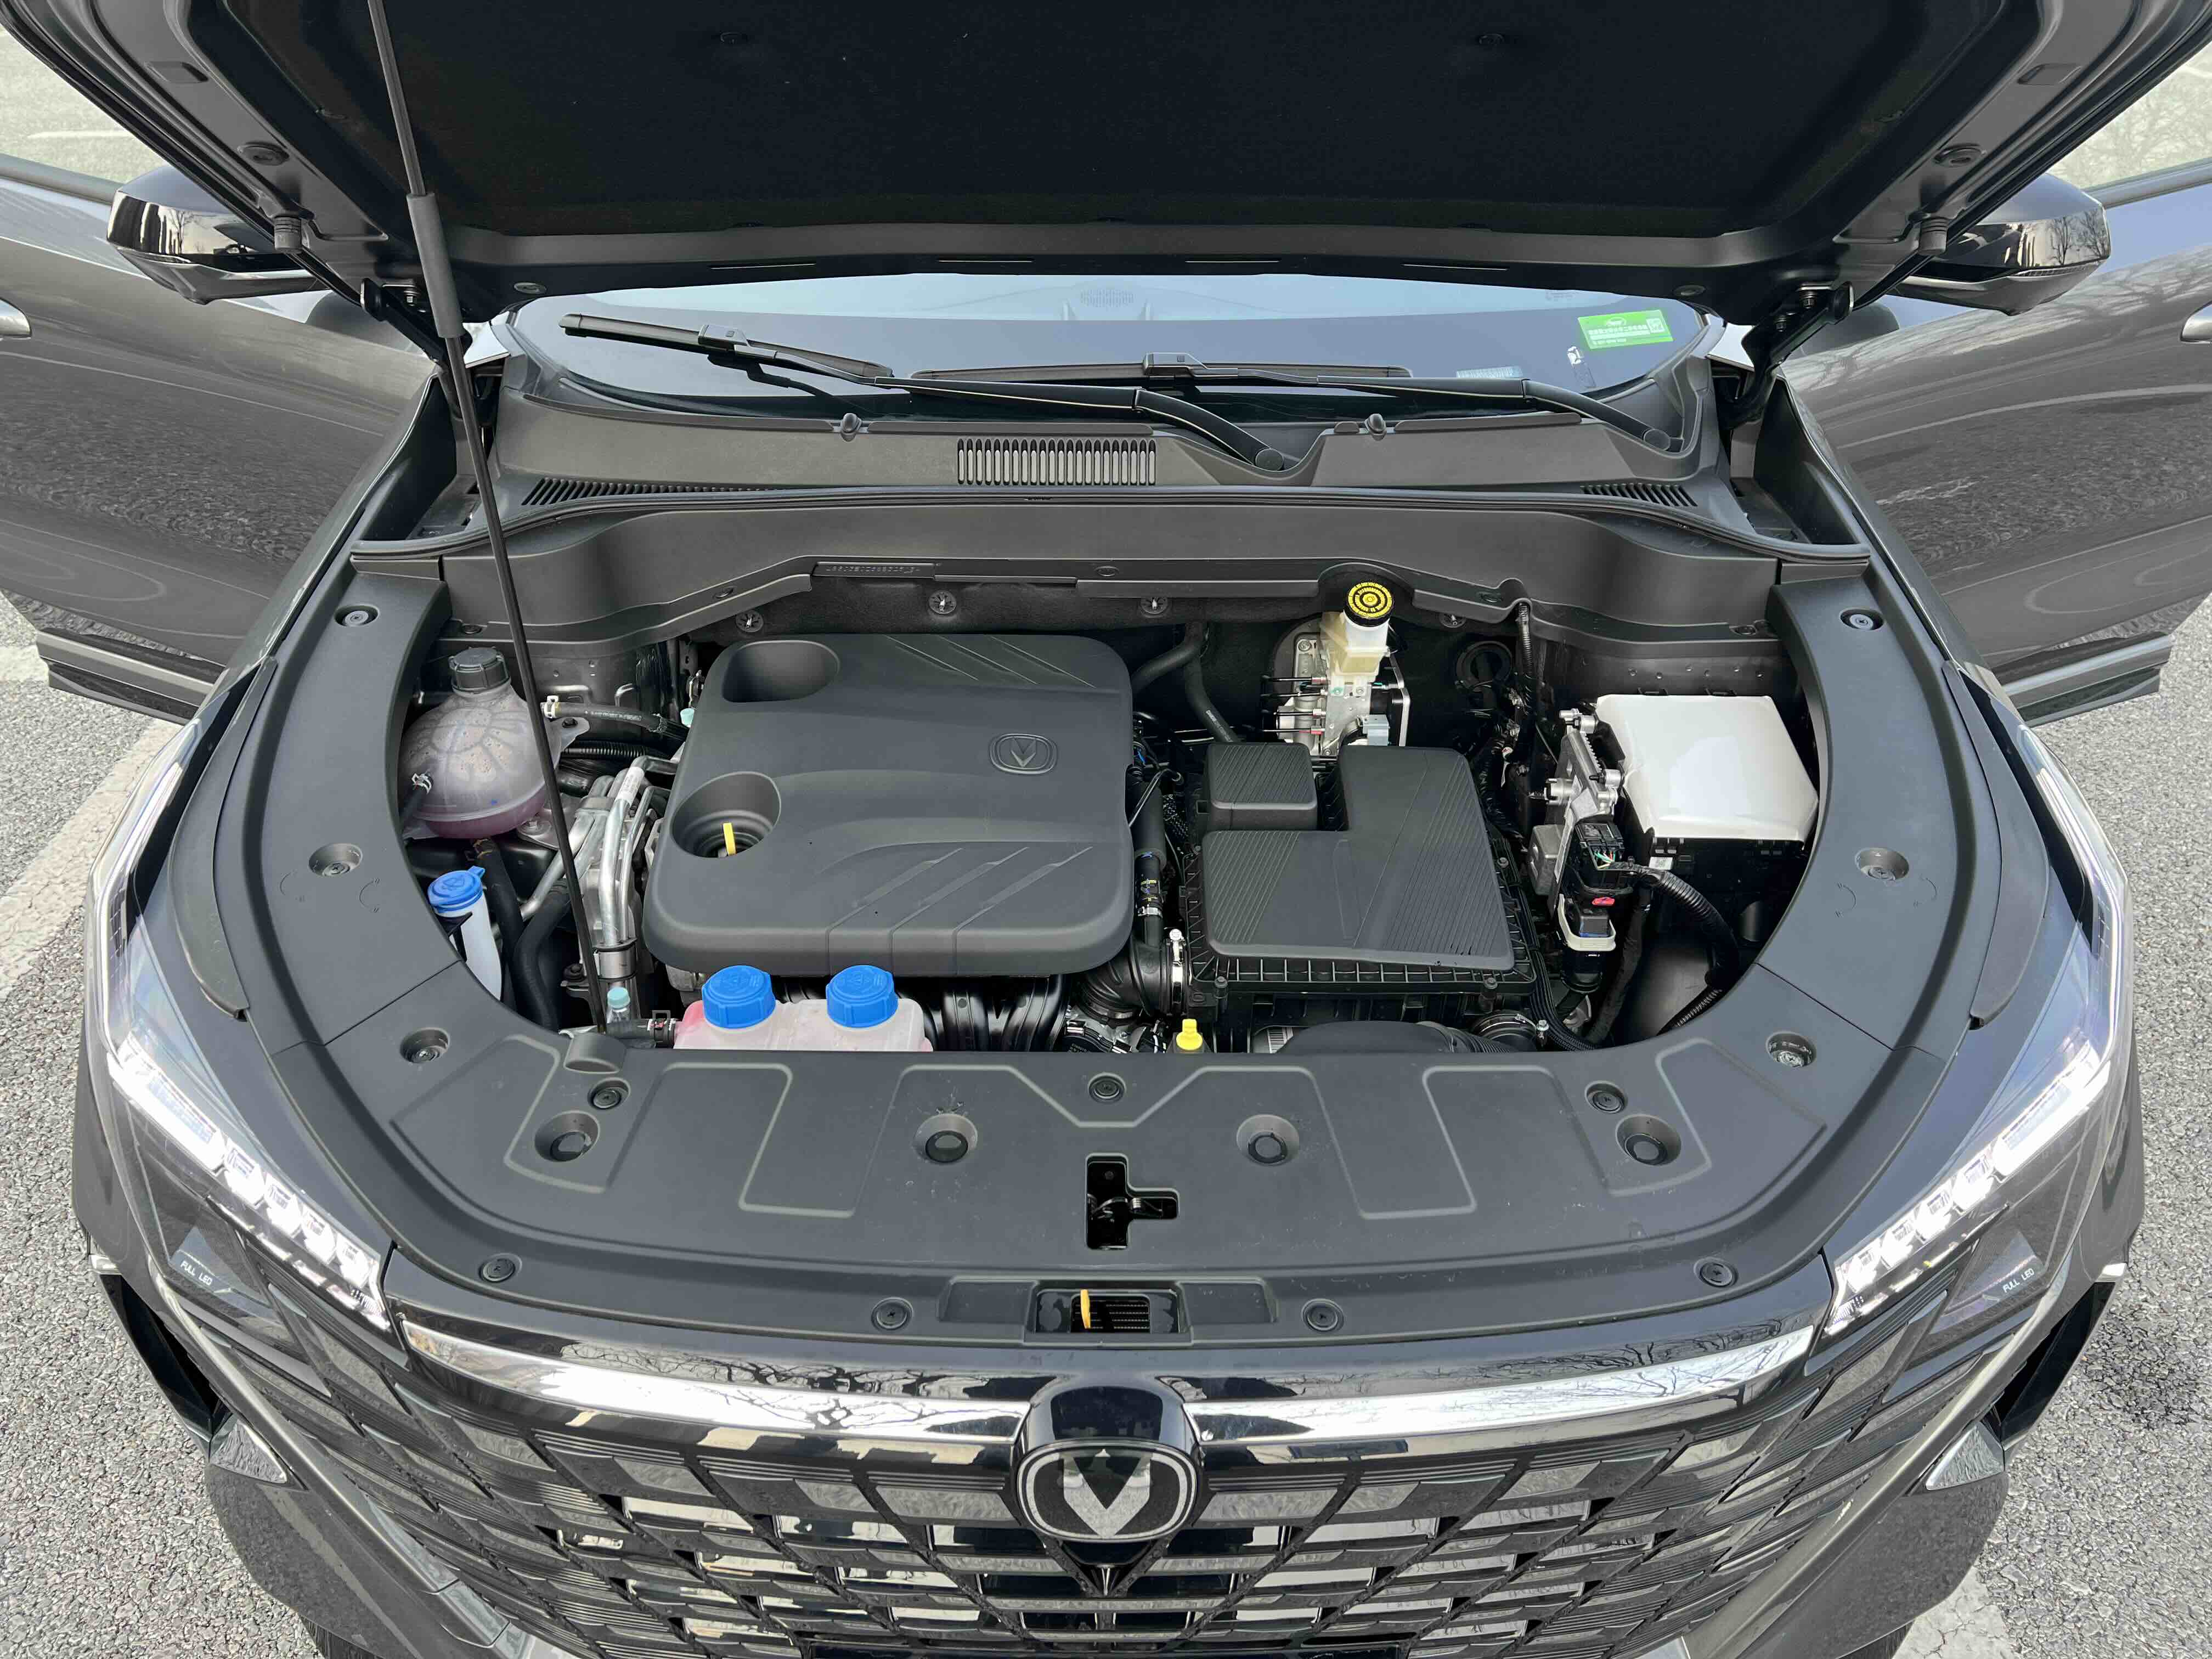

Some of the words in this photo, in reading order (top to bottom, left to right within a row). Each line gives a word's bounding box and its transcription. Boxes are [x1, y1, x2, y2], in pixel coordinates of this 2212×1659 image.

[180, 1260, 196, 1276] FULL
[198, 1272, 213, 1286] LED
[2002, 1278, 2020, 1293] FULL
[2021, 1268, 2035, 1280] LED
